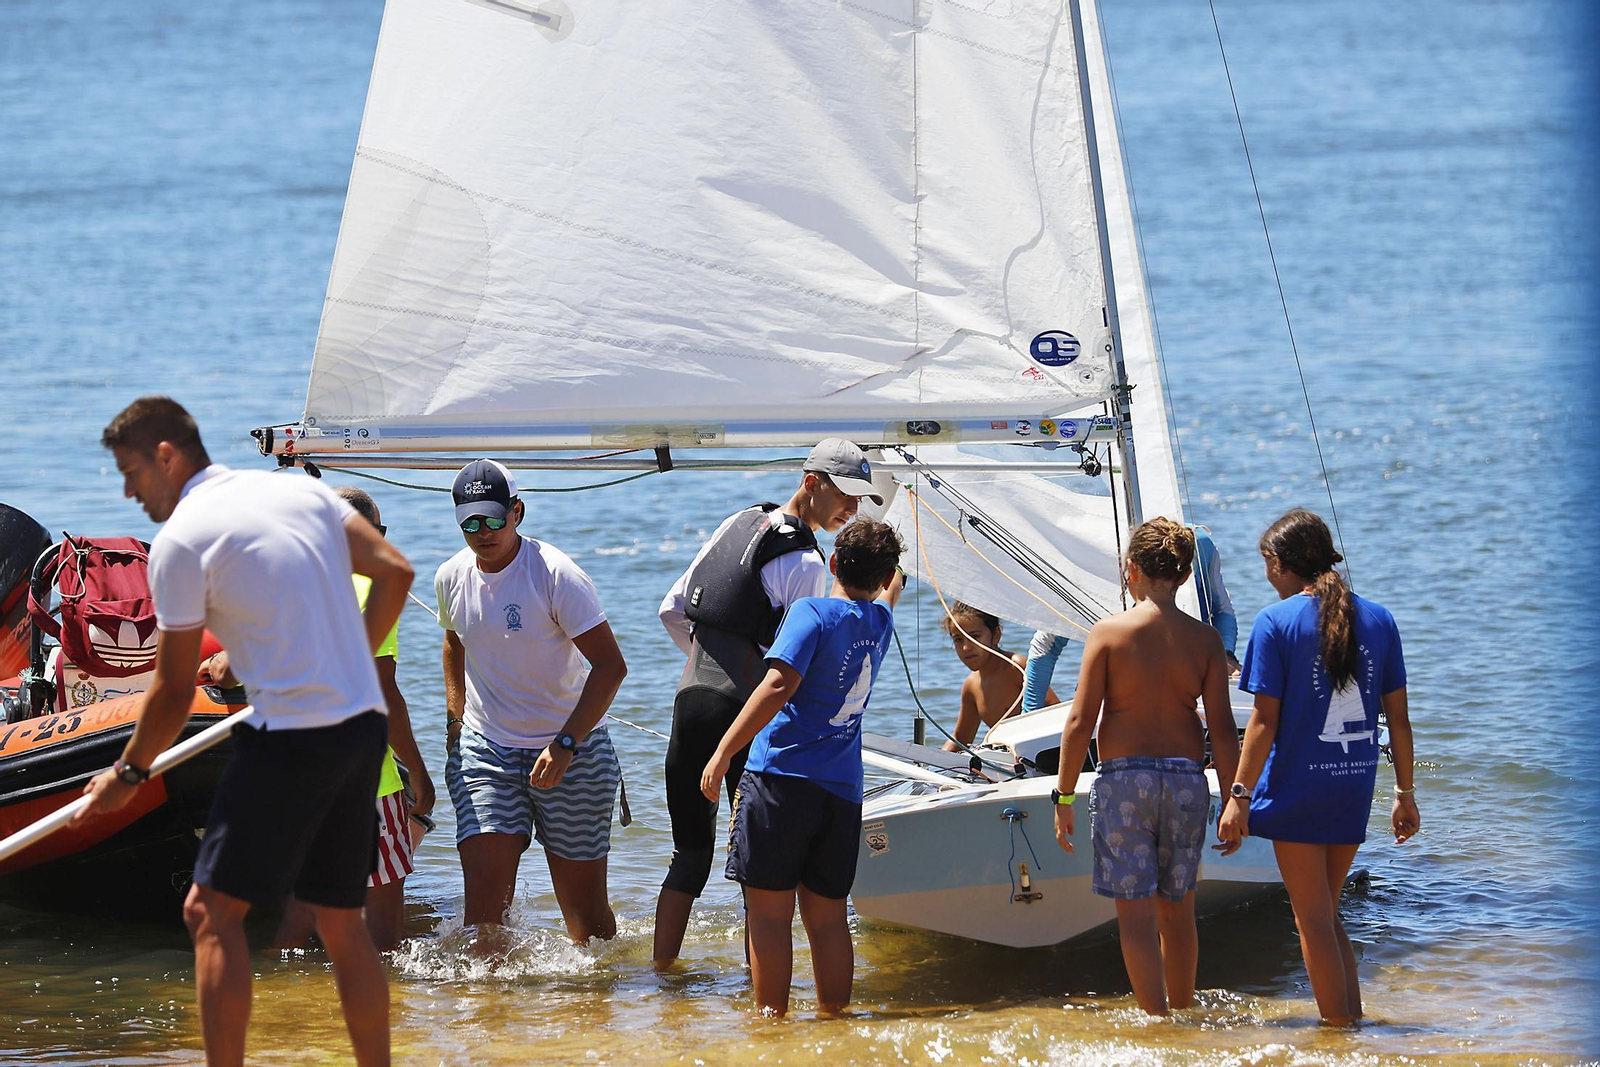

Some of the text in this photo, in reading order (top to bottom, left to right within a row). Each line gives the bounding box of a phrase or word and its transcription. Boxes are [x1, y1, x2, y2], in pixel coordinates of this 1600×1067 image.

[838, 649, 852, 682] TROFEO
[1312, 654, 1323, 691] TROFEO
[1359, 644, 1370, 656] DE
